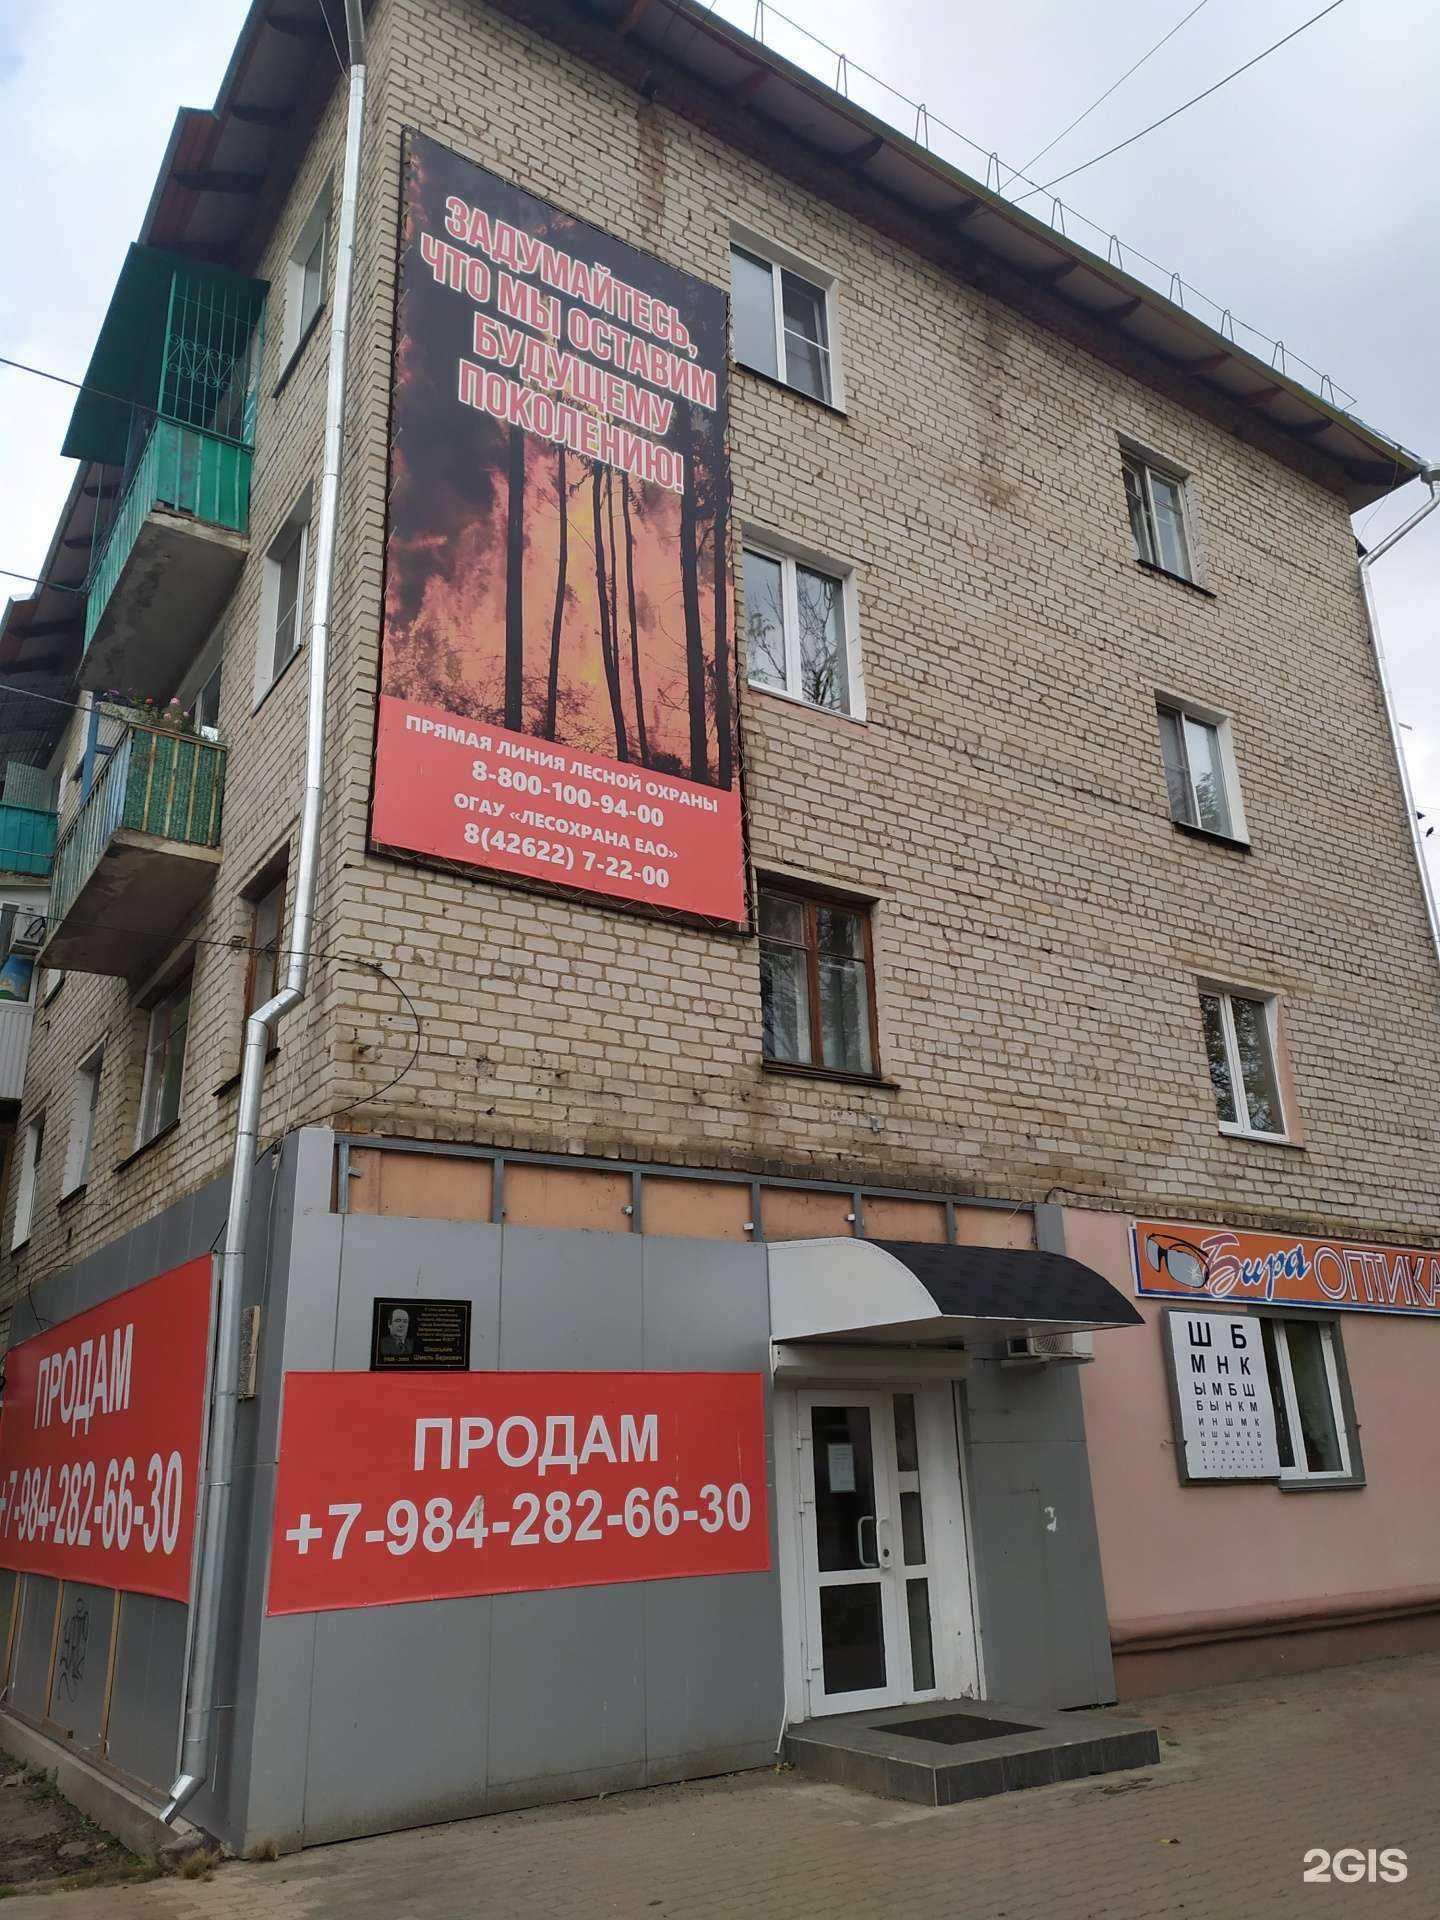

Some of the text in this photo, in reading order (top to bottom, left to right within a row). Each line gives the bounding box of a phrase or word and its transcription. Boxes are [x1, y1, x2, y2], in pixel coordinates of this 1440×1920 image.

[420, 231, 717, 411] ЧТО МЫ ОСТАВИМ
[444, 196, 698, 358] ЗАДУМАЙТЕСЬ,
[473, 311, 673, 436] БУДУЩЕМУ
[458, 358, 685, 495] ПОКОЛЕНИЮ!
[405, 714, 719, 813] ПРЯМАЯ ЛИНИЯ ЛЕСНОЙ ОХРАНЫ
[471, 760, 665, 827] 8-800-100-94-00
[453, 792, 680, 860] ОГАУ «ЛЕСОХРАНА ЕАО»
[463, 822, 670, 889] 8(42622) 7-22-00
[1201, 1233, 1312, 1301] Бира
[1188, 1321, 1247, 1349] Ш Б
[33, 1322, 134, 1438] ПРОДАМ
[413, 1414, 659, 1476] ПРОДАМ
[0, 1449, 183, 1556] +7-984-282-66-30
[286, 1482, 751, 1560] +7-984-282-66-30
